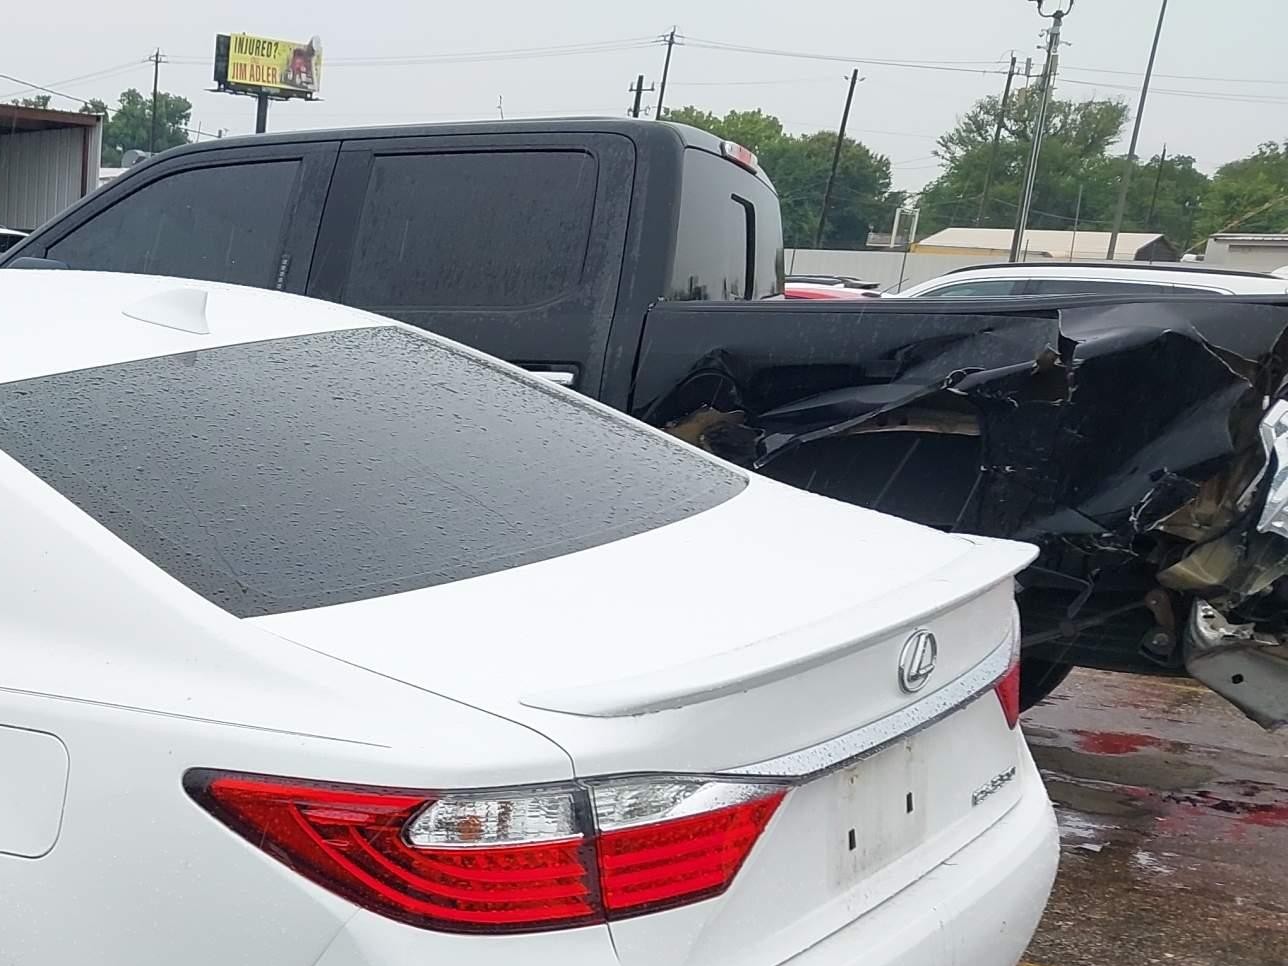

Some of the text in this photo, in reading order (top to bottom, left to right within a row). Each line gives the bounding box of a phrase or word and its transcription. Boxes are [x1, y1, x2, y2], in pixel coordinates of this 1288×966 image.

[234, 36, 279, 59] INJURED?
[232, 62, 278, 85] JIM ADLER
